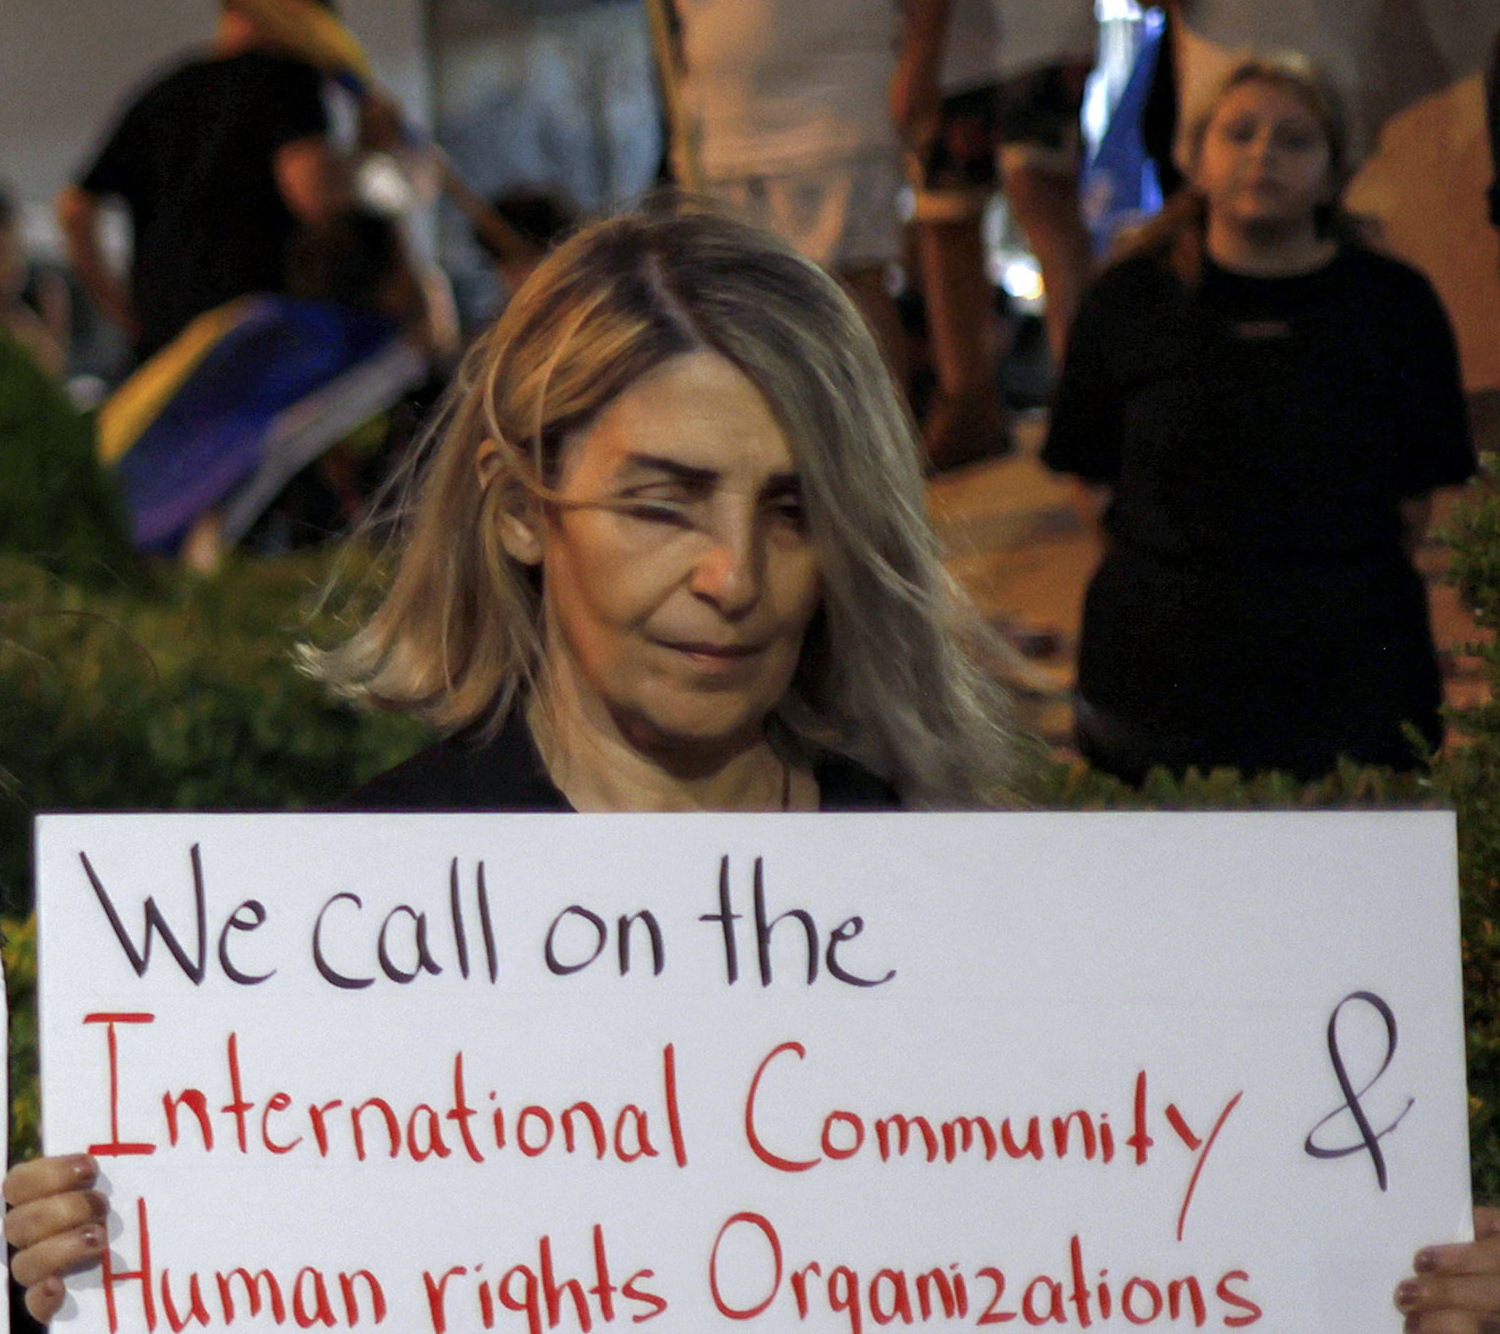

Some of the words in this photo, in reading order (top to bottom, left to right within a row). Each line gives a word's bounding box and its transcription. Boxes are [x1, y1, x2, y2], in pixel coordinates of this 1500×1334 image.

[77, 842, 277, 987] We
[543, 904, 665, 977] on
[697, 854, 897, 989] the
[83, 1010, 688, 1169] International
[744, 1040, 1244, 1243] Community
[1303, 990, 1416, 1193] &
